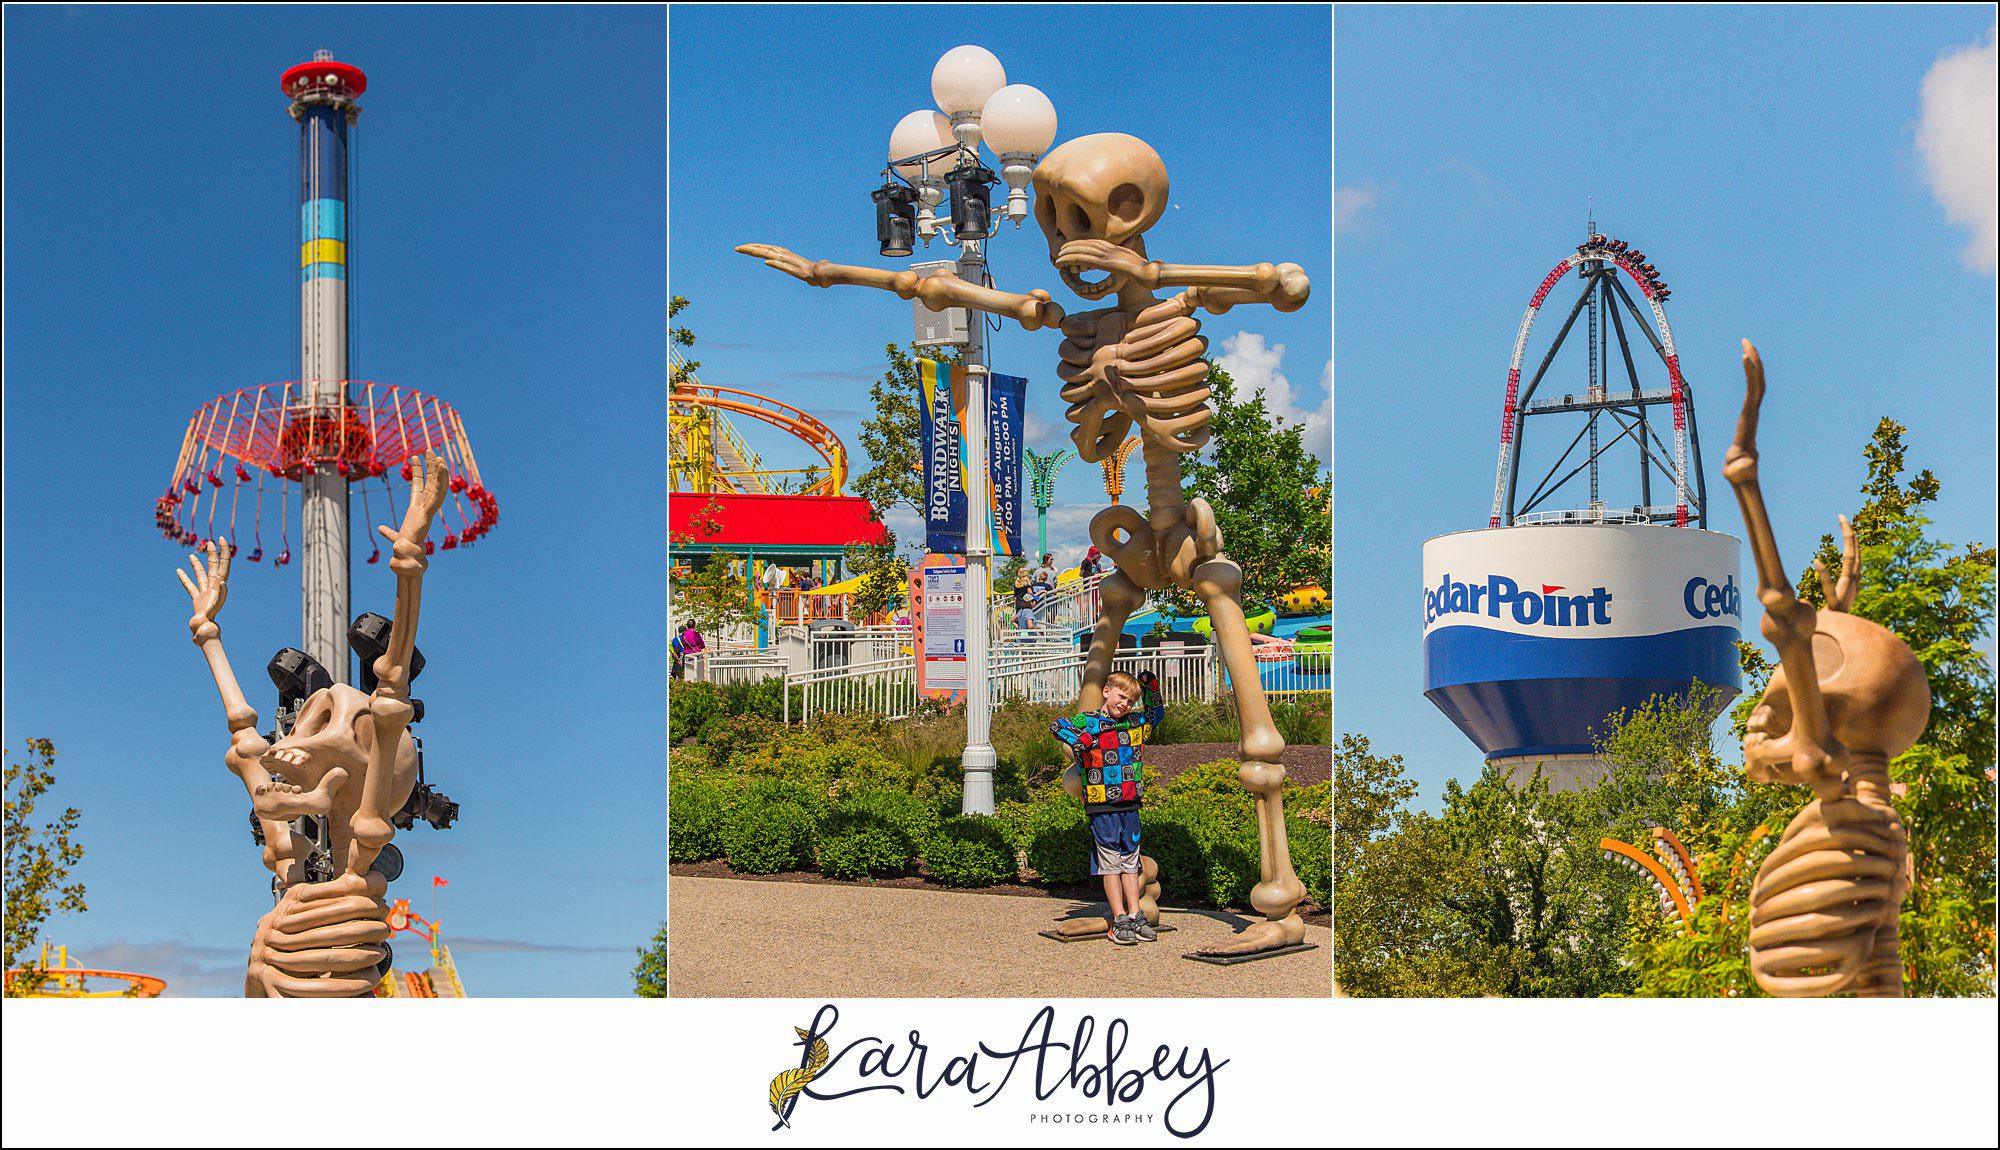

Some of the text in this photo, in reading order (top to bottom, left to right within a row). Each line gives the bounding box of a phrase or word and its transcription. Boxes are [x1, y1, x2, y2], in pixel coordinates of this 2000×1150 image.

[990, 400, 998, 416] 17
[1000, 397, 1009, 418] PM
[931, 385, 950, 522] BOARDWALK
[992, 419, 1002, 471] August
[1002, 421, 1011, 462] 10:00
[949, 425, 960, 490] NIGHTS
[994, 484, 1002, 500] 18
[1004, 476, 1012, 498] PM
[993, 503, 1004, 532] July
[1005, 501, 1013, 535] 7:00
